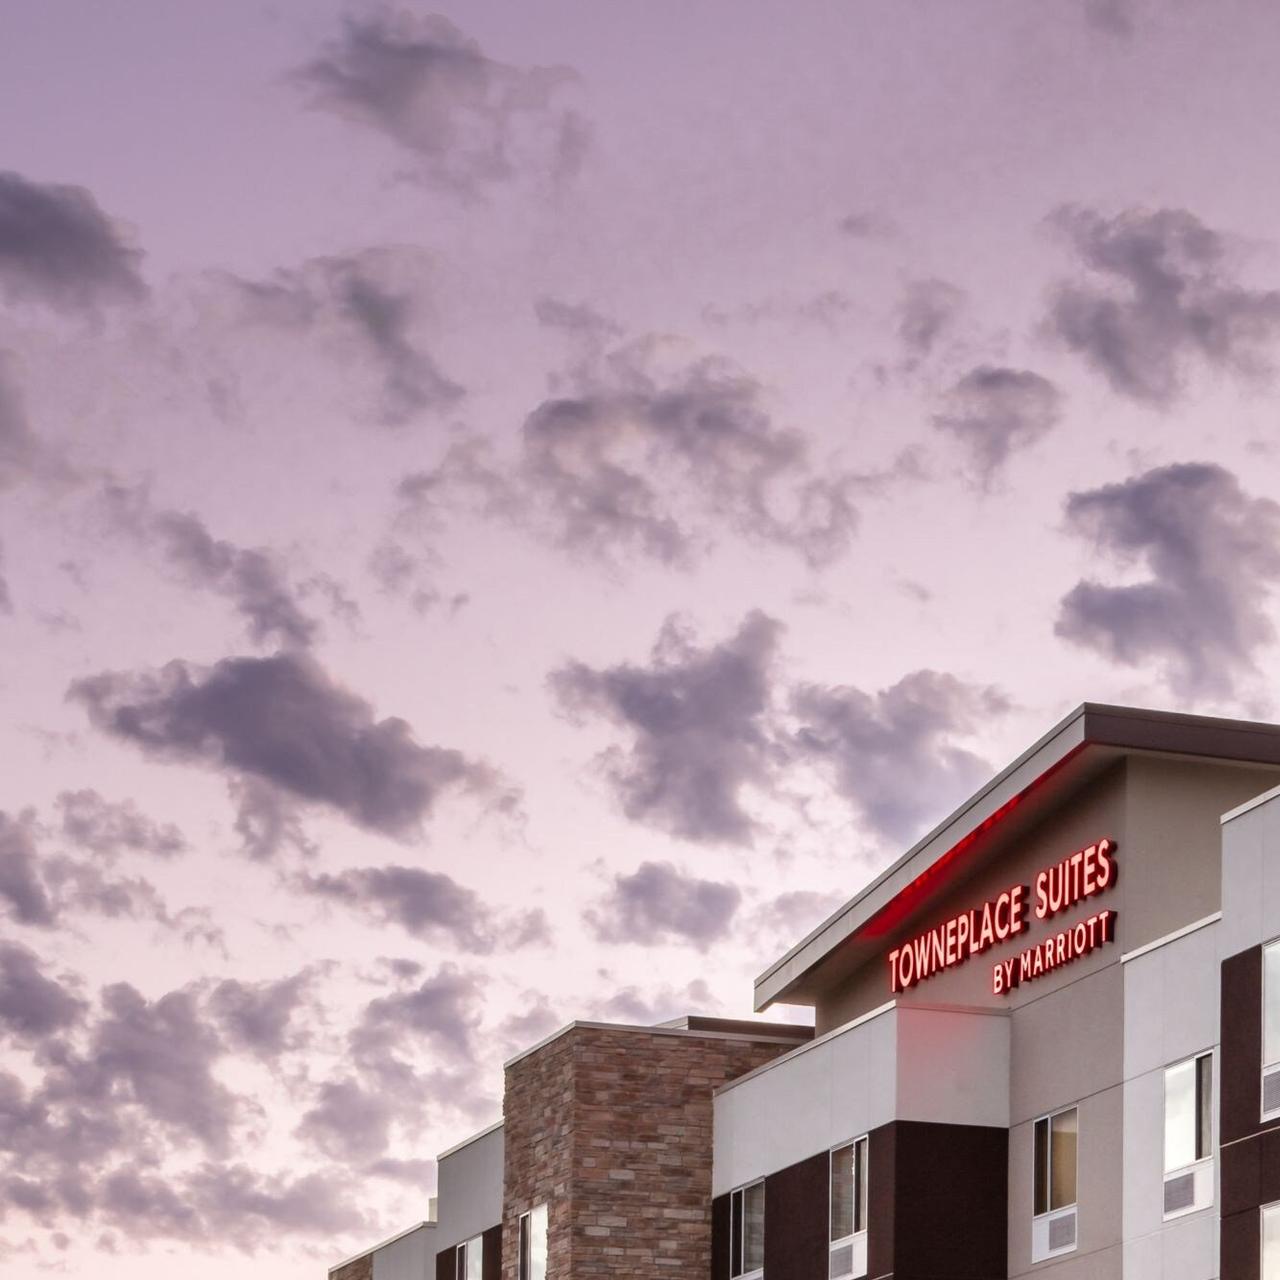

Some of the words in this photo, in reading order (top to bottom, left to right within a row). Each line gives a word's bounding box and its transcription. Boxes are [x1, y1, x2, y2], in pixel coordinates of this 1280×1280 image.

[889, 886, 1029, 992] TOWNEPLACE
[1036, 839, 1117, 918] SUITES
[993, 957, 1018, 994] BY
[1020, 911, 1116, 981] MARRIOTT
